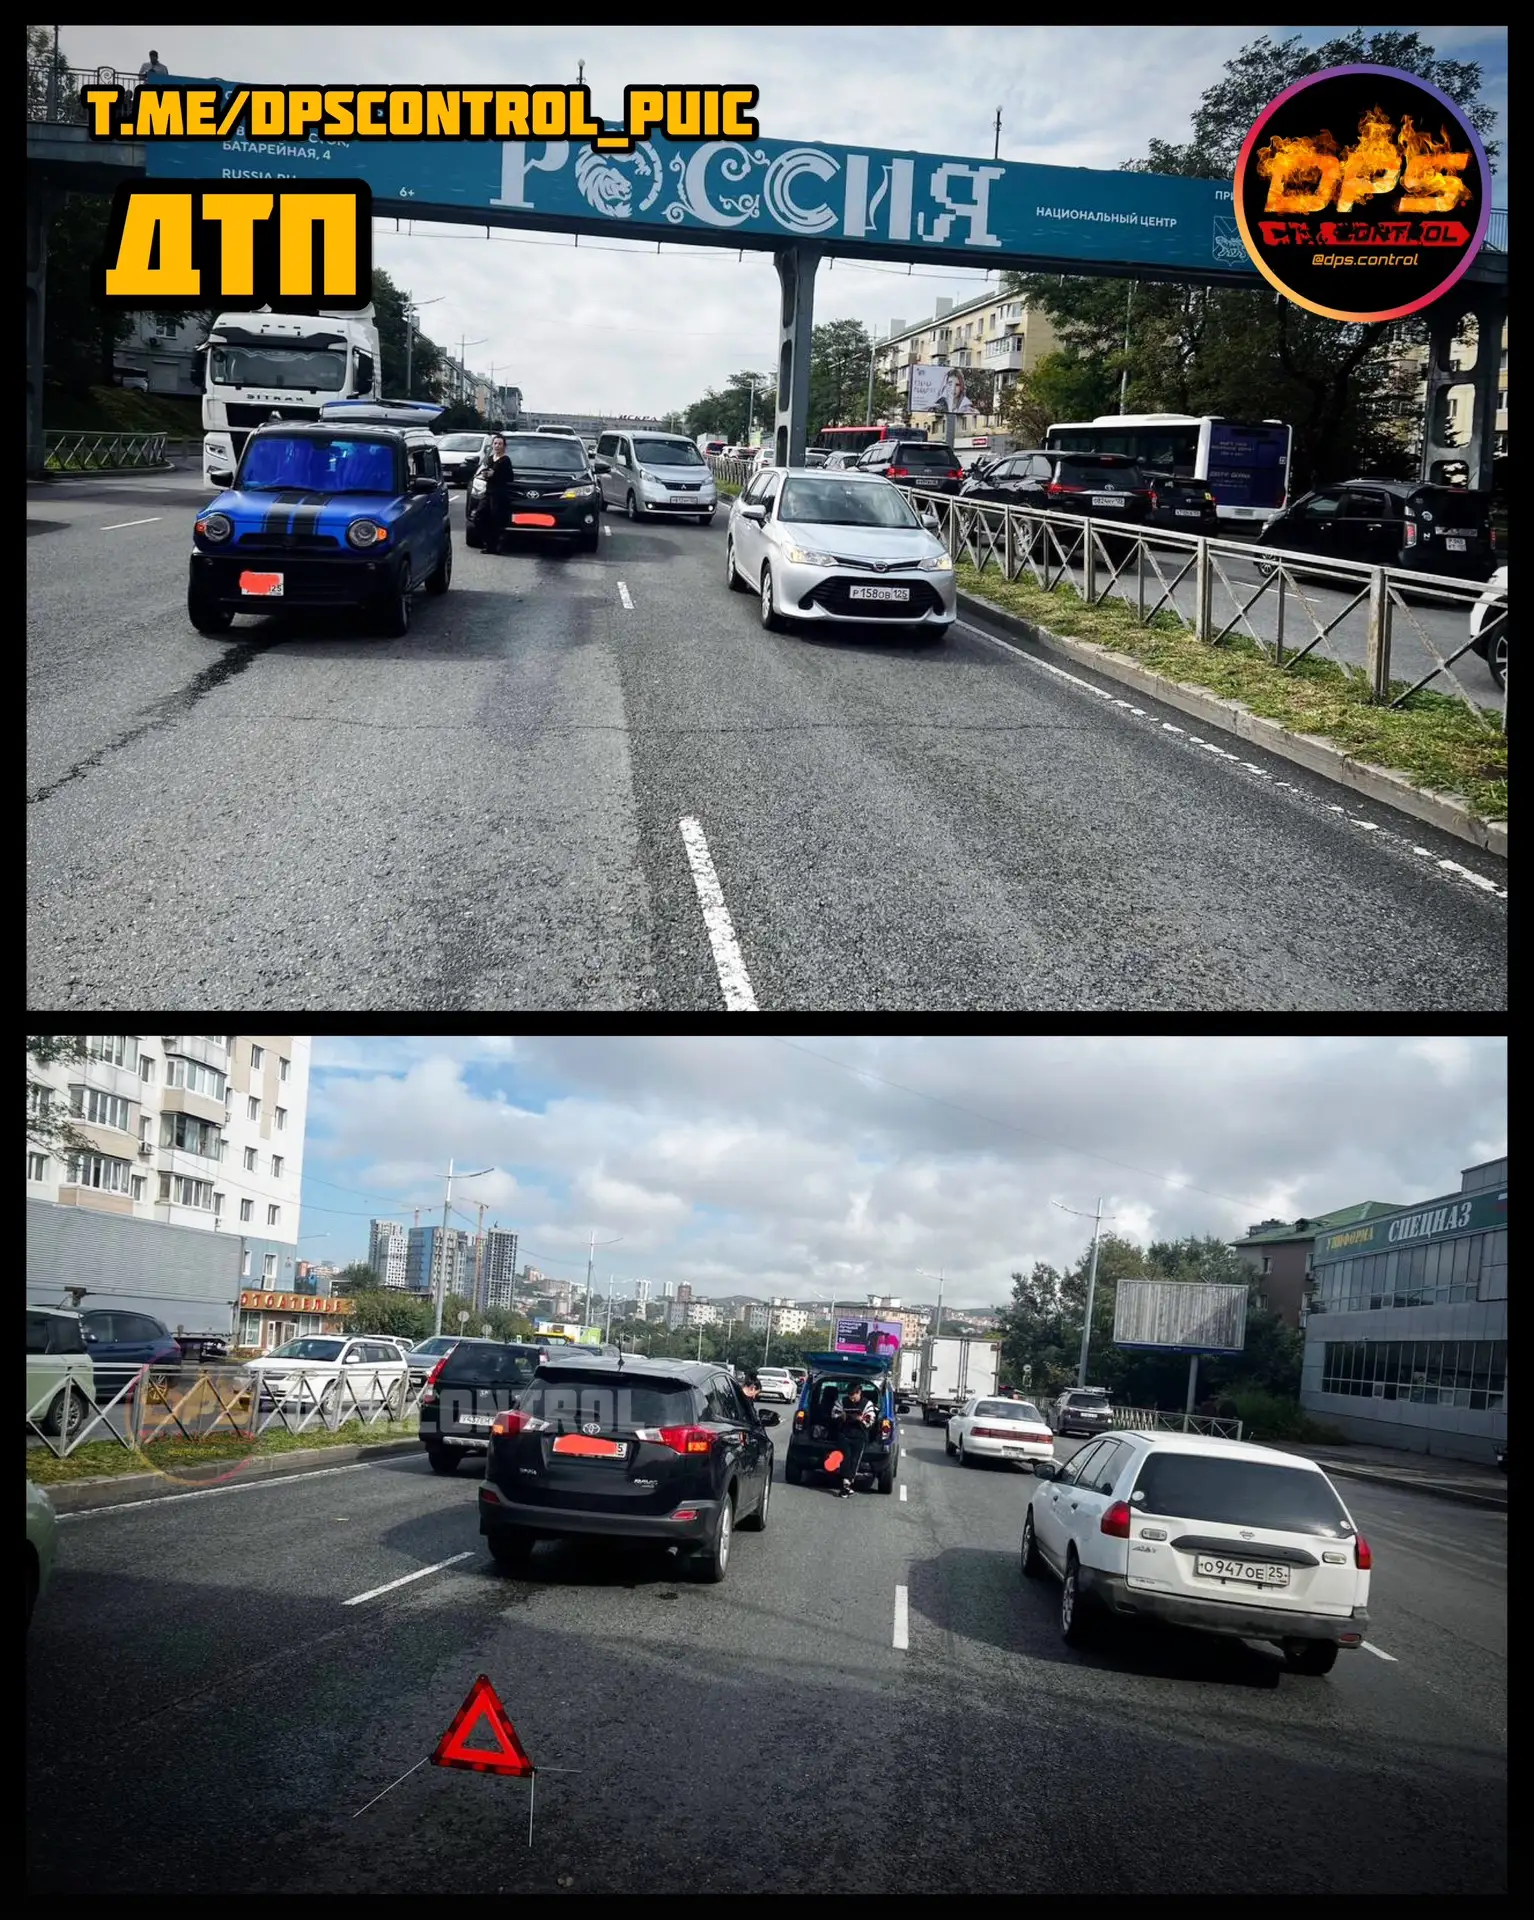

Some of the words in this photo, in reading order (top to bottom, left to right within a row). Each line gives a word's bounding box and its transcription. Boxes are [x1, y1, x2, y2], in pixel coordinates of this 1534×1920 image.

[222, 140, 321, 161] БАТАРЕЙНАЯ,
[322, 150, 332, 161] 4
[399, 186, 415, 198] 6+
[1036, 206, 1138, 225] НАЦИОНАЛЬНЫЙ
[1140, 217, 1177, 229] ЦЕНТР
[1388, 1201, 1473, 1243] СПЕЦНАЗ
[241, 1293, 342, 1313] ОТОАТЕЛЬЕ
[1205, 1560, 1264, 1580] О947ОЕ
[1268, 1566, 1283, 1578] 25
